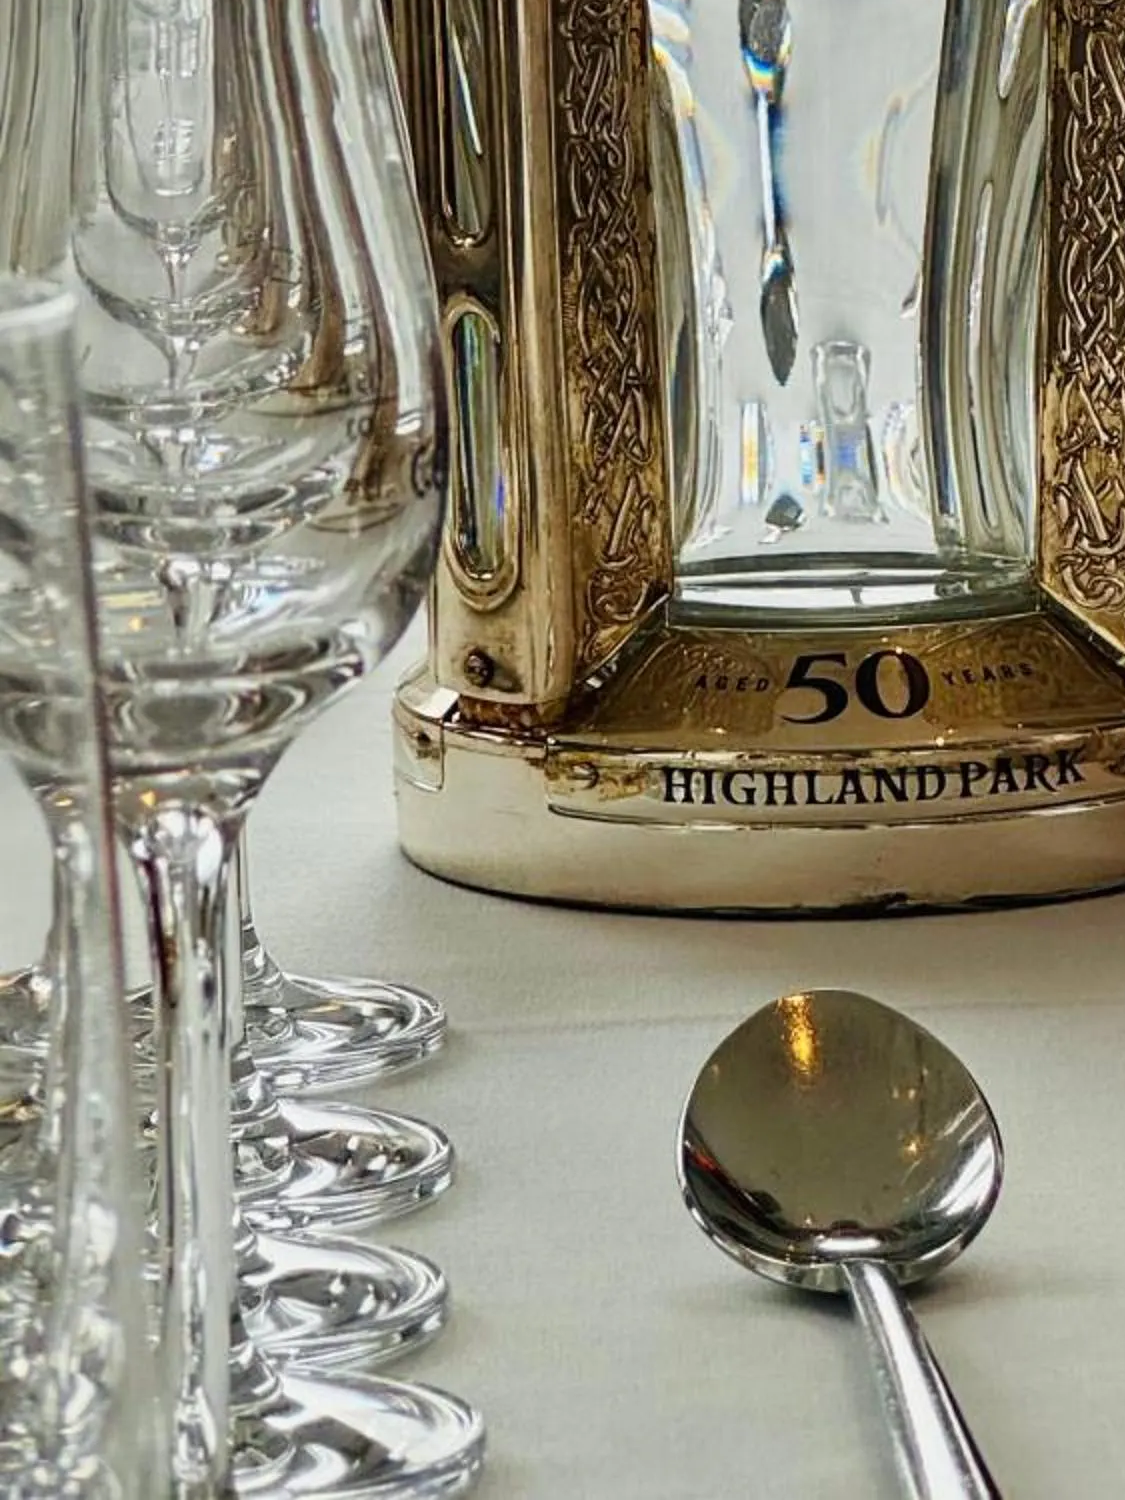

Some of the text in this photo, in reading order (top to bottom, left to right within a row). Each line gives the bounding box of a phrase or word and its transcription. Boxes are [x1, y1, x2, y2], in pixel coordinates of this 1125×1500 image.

[694, 650, 1034, 725] AGED 50 YEARS
[662, 744, 1087, 806] HIGHLAND PARK
